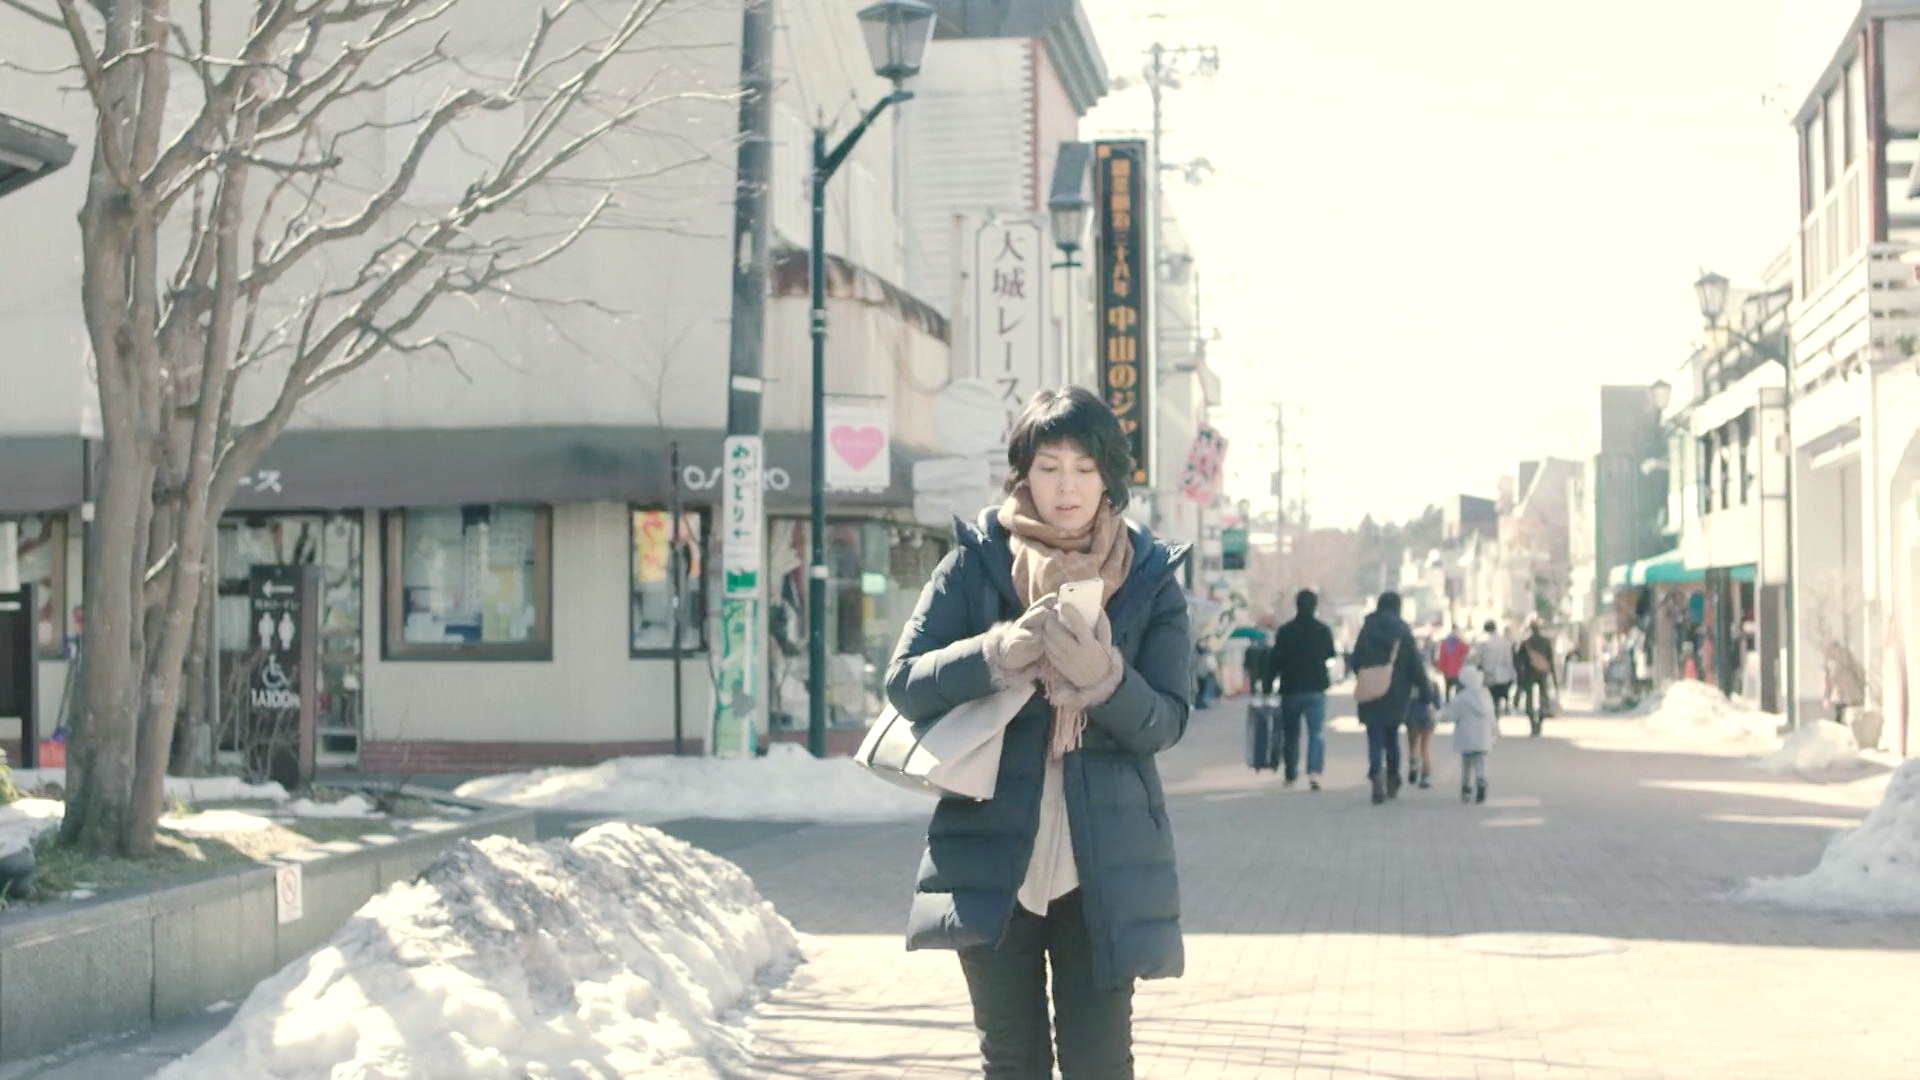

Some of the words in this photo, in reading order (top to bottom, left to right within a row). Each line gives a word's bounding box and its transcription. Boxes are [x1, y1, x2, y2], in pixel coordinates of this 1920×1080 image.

[992, 231, 1025, 443] 大城レース
[1108, 305, 1138, 434] 中山のジャ
